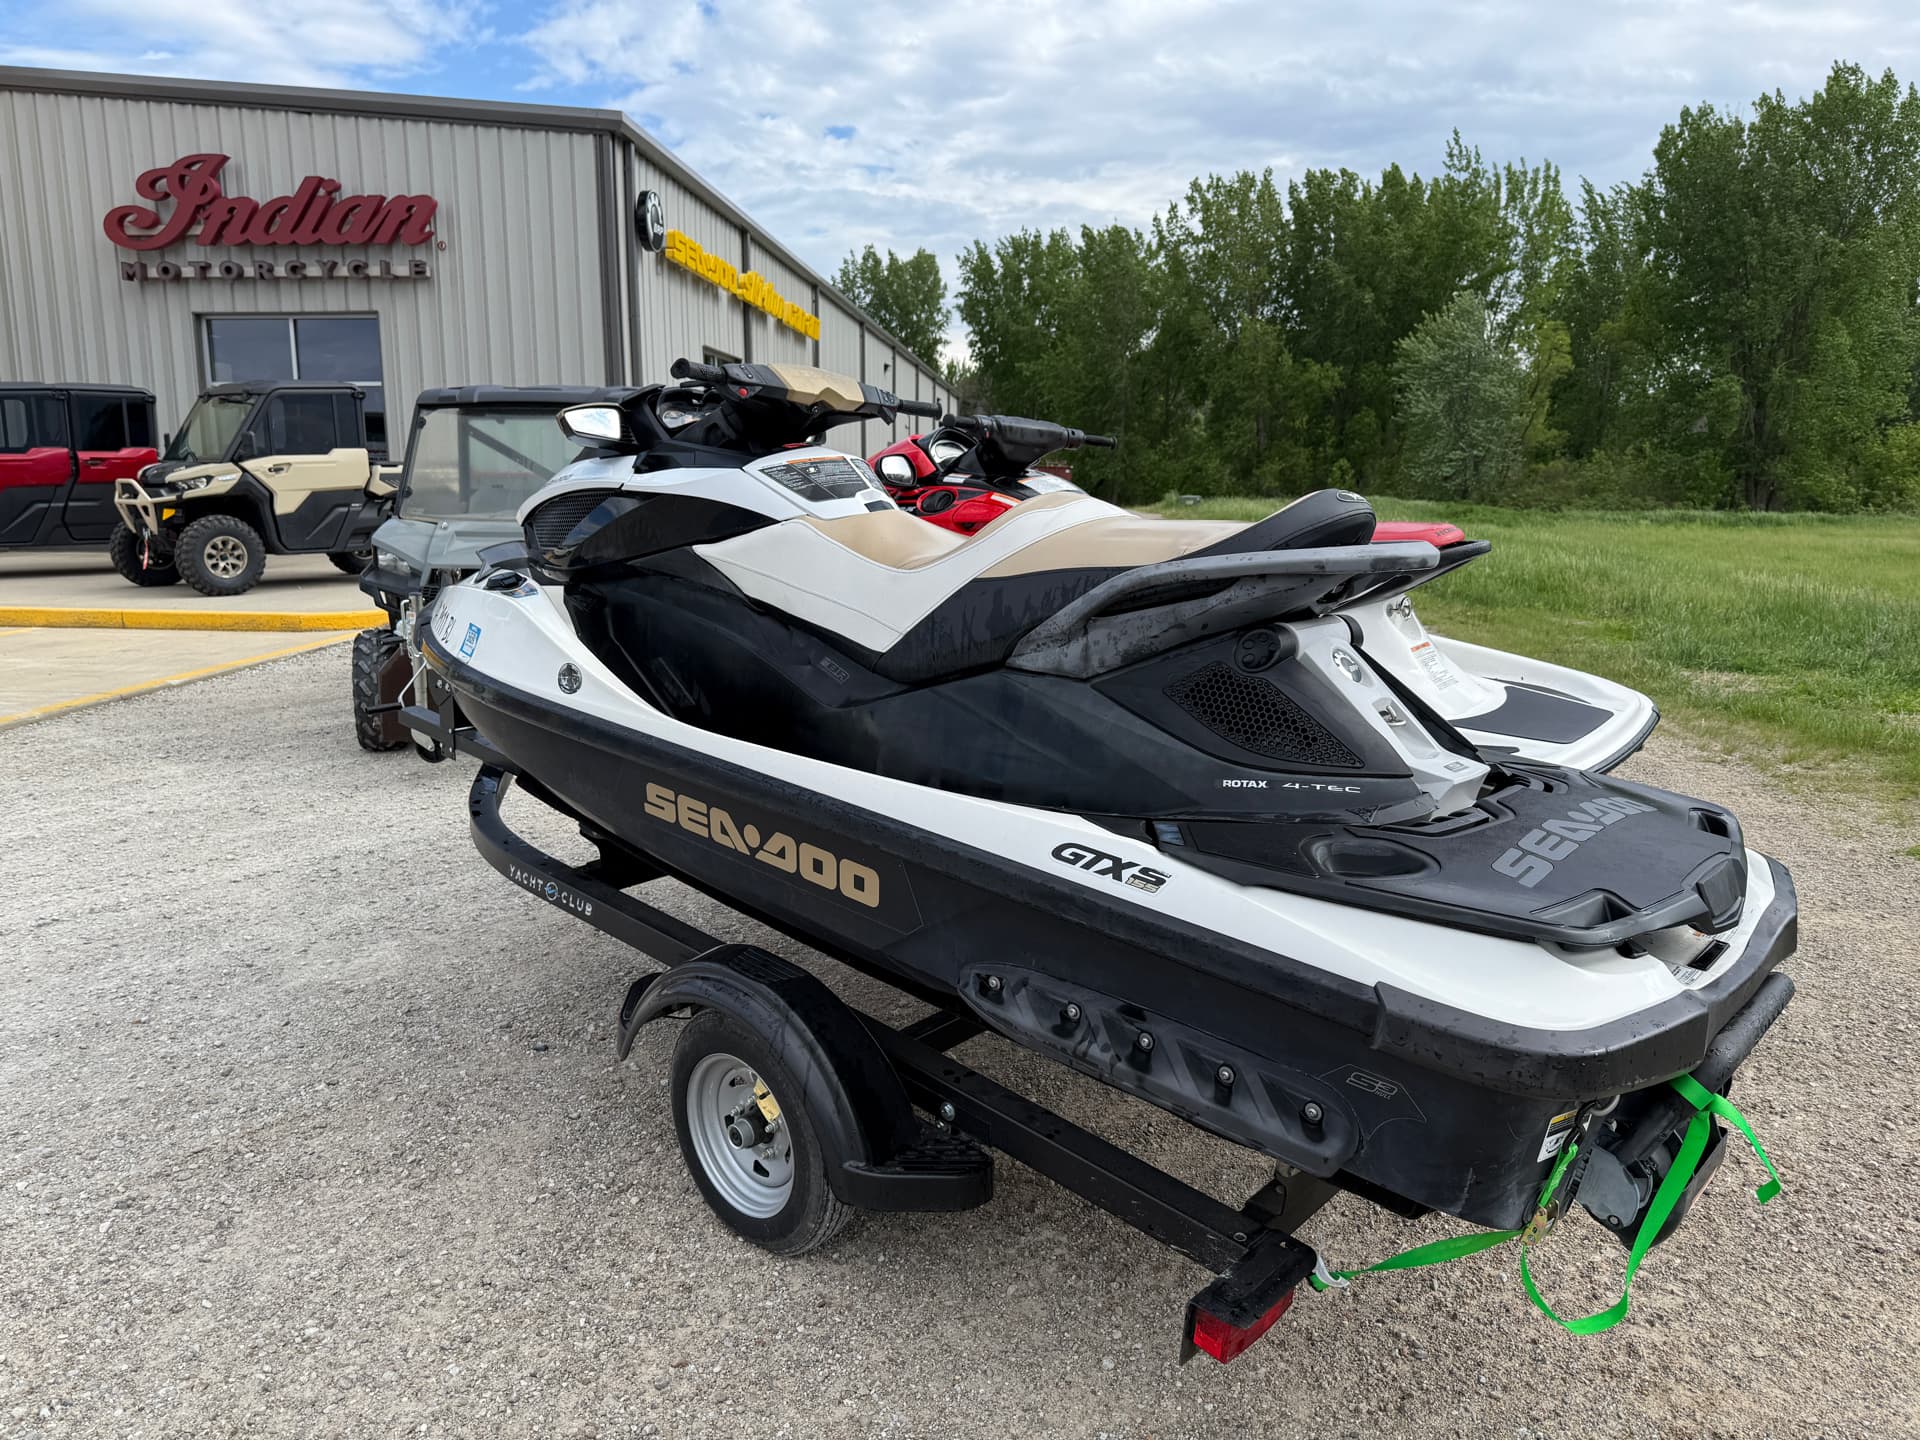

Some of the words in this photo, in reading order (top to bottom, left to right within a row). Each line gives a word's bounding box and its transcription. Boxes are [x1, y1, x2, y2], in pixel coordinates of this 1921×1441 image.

[103, 153, 439, 250] Indian
[121, 259, 430, 282] MOTORCYCLE
[1222, 779, 1268, 788] ROTAX
[1281, 782, 1361, 793] 4-TEC
[509, 864, 543, 891] YACHT
[561, 891, 593, 916] CLUB
